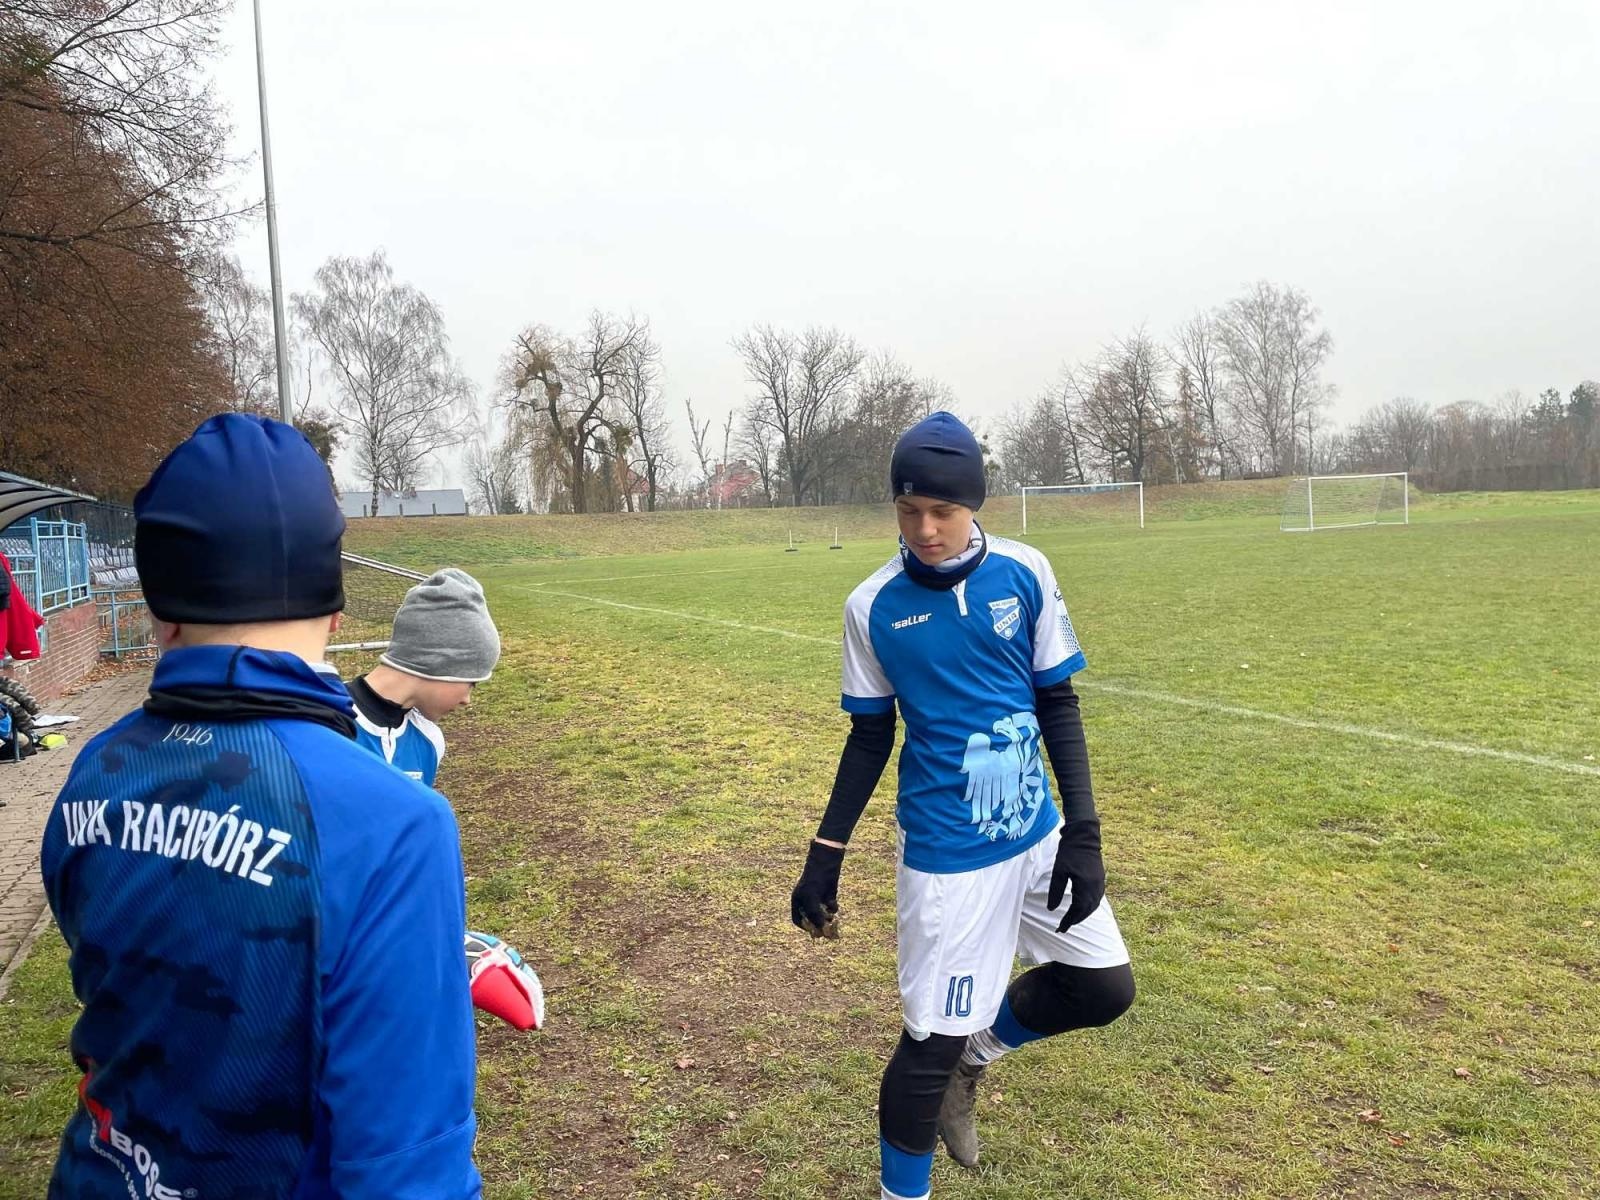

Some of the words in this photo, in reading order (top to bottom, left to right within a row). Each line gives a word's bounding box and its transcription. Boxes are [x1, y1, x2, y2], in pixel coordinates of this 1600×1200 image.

[162, 723, 213, 746] 1946
[121, 800, 292, 887] RACIBÓRZ
[945, 975, 973, 1017] 10
